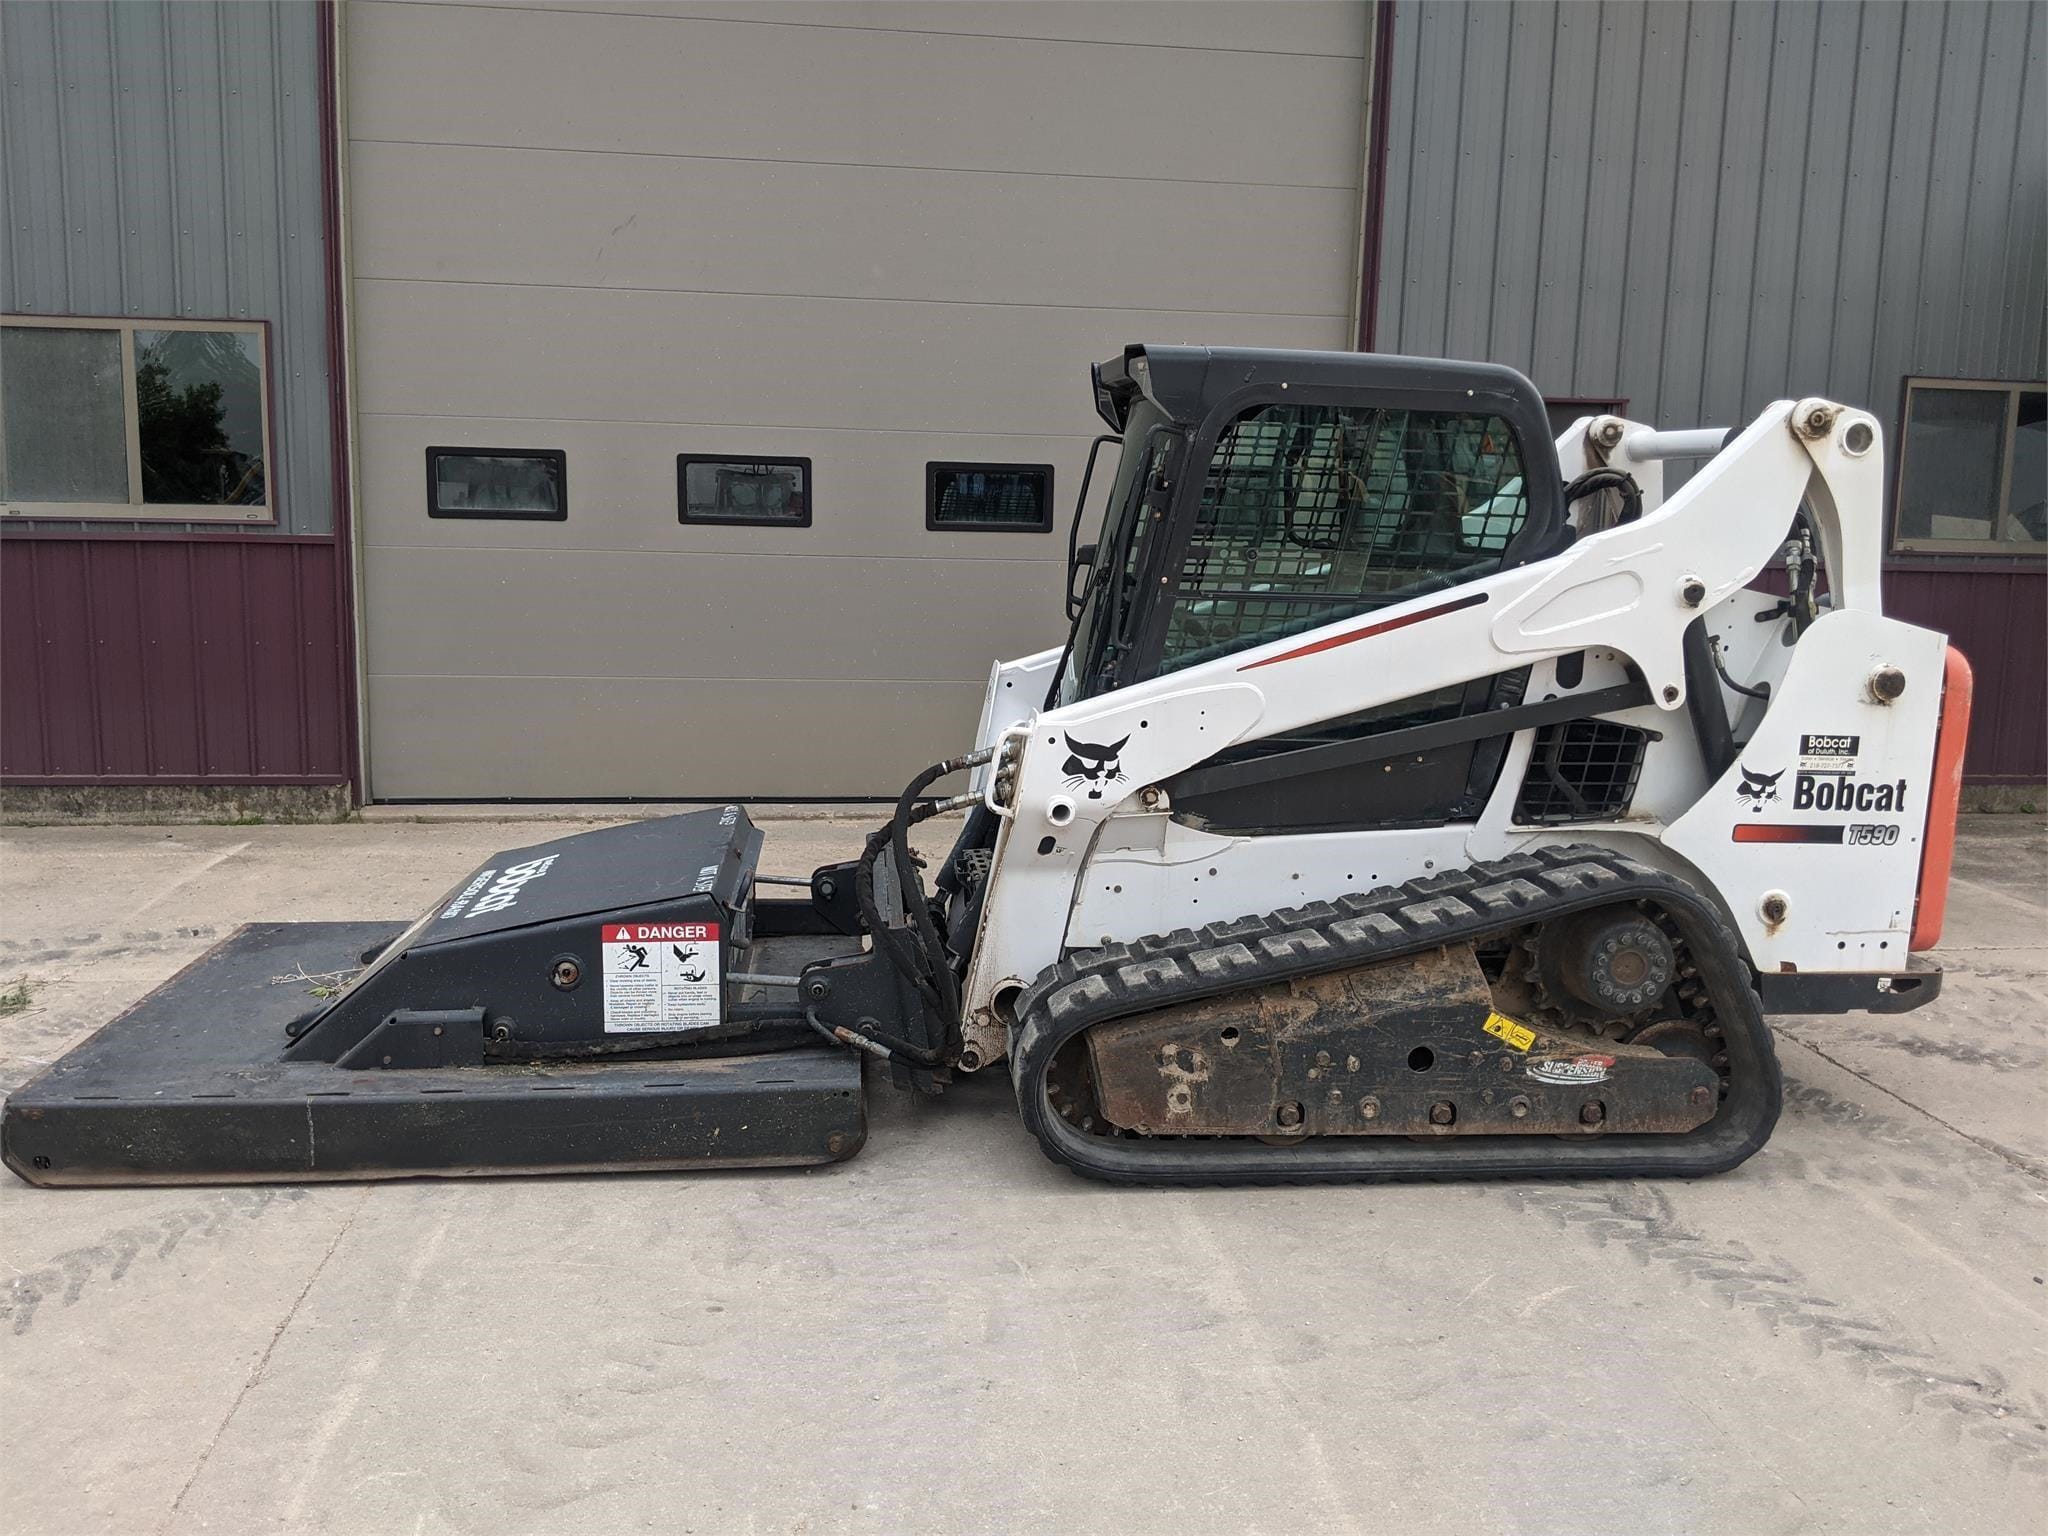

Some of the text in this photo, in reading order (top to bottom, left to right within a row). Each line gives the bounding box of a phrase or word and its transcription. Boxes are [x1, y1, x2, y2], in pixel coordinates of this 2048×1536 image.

[1808, 736, 1851, 748] Bobcat
[1793, 775, 1907, 812] Bobcat
[1848, 824, 1900, 845] T590
[637, 926, 707, 939] DANGER
